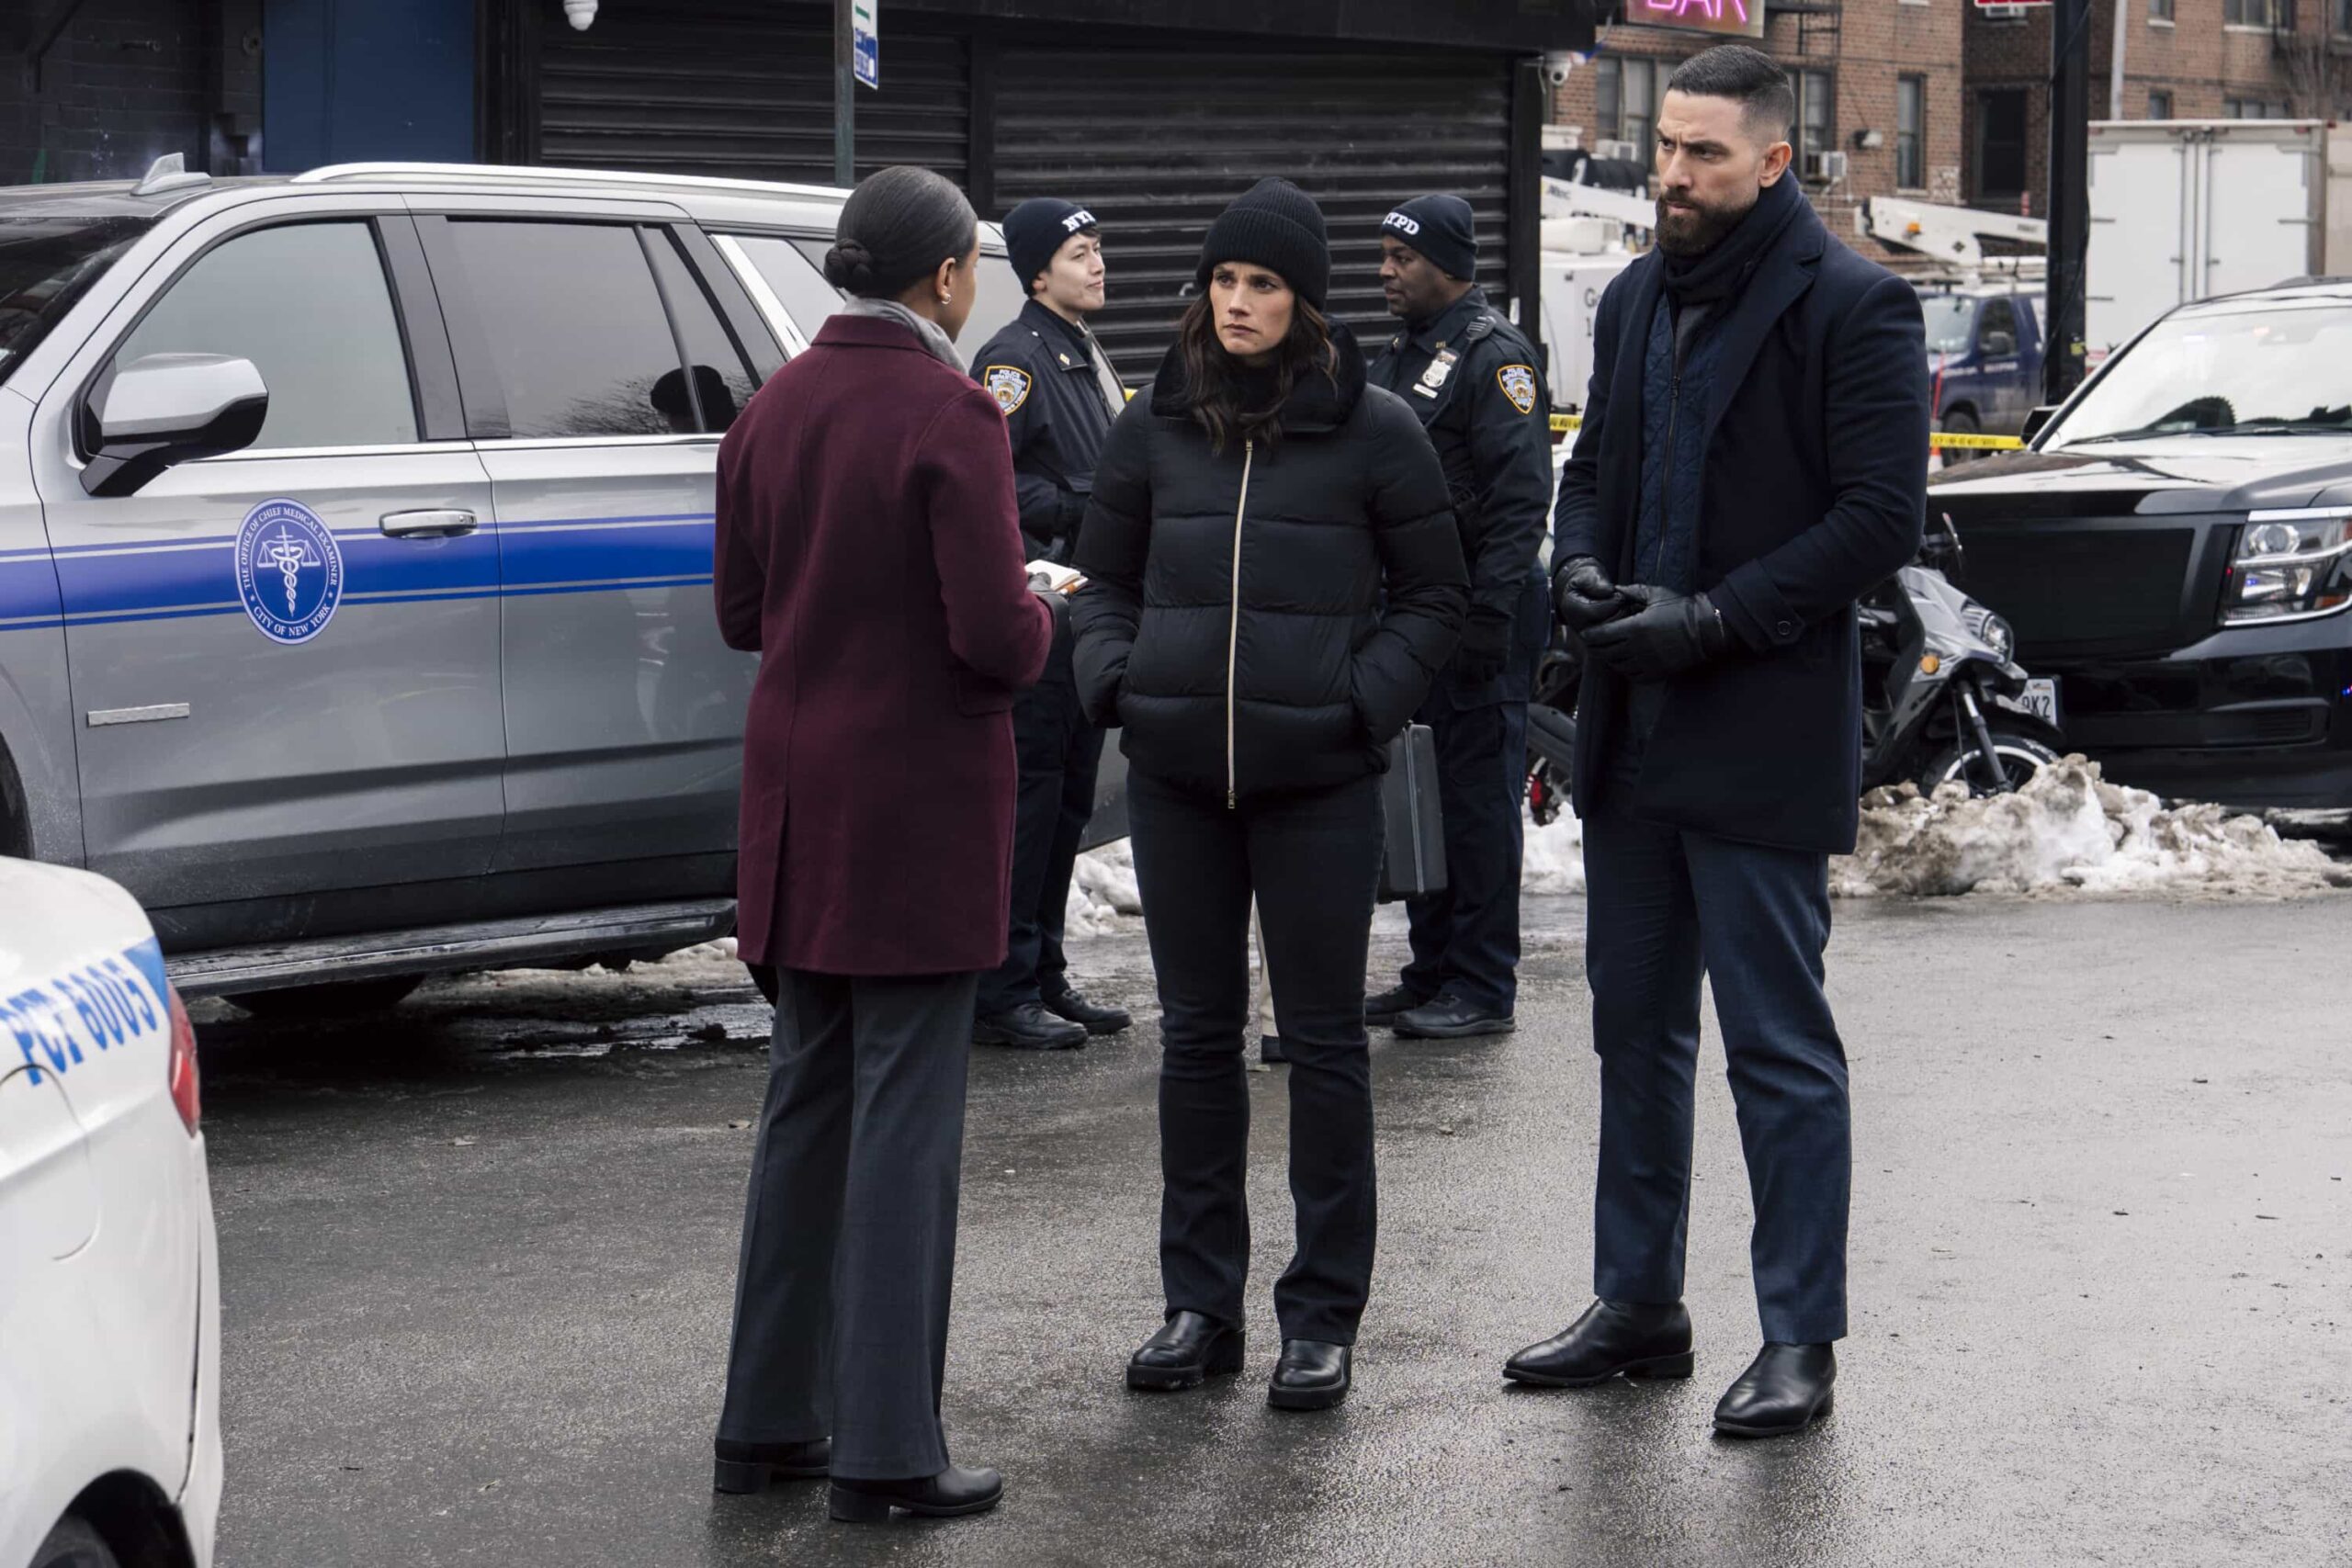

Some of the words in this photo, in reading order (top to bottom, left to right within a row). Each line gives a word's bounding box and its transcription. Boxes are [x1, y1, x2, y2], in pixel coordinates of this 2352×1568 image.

[250, 519, 260, 531] OF
[258, 506, 281, 523] CHIEF
[283, 507, 319, 535] MEDICAL
[241, 531, 254, 566] OFFICE
[318, 530, 338, 586] EXAMINER
[241, 567, 252, 591] THE
[254, 605, 273, 629] CITY
[273, 624, 286, 637] OF
[288, 622, 310, 637] NEW
[311, 603, 331, 629] YORK
